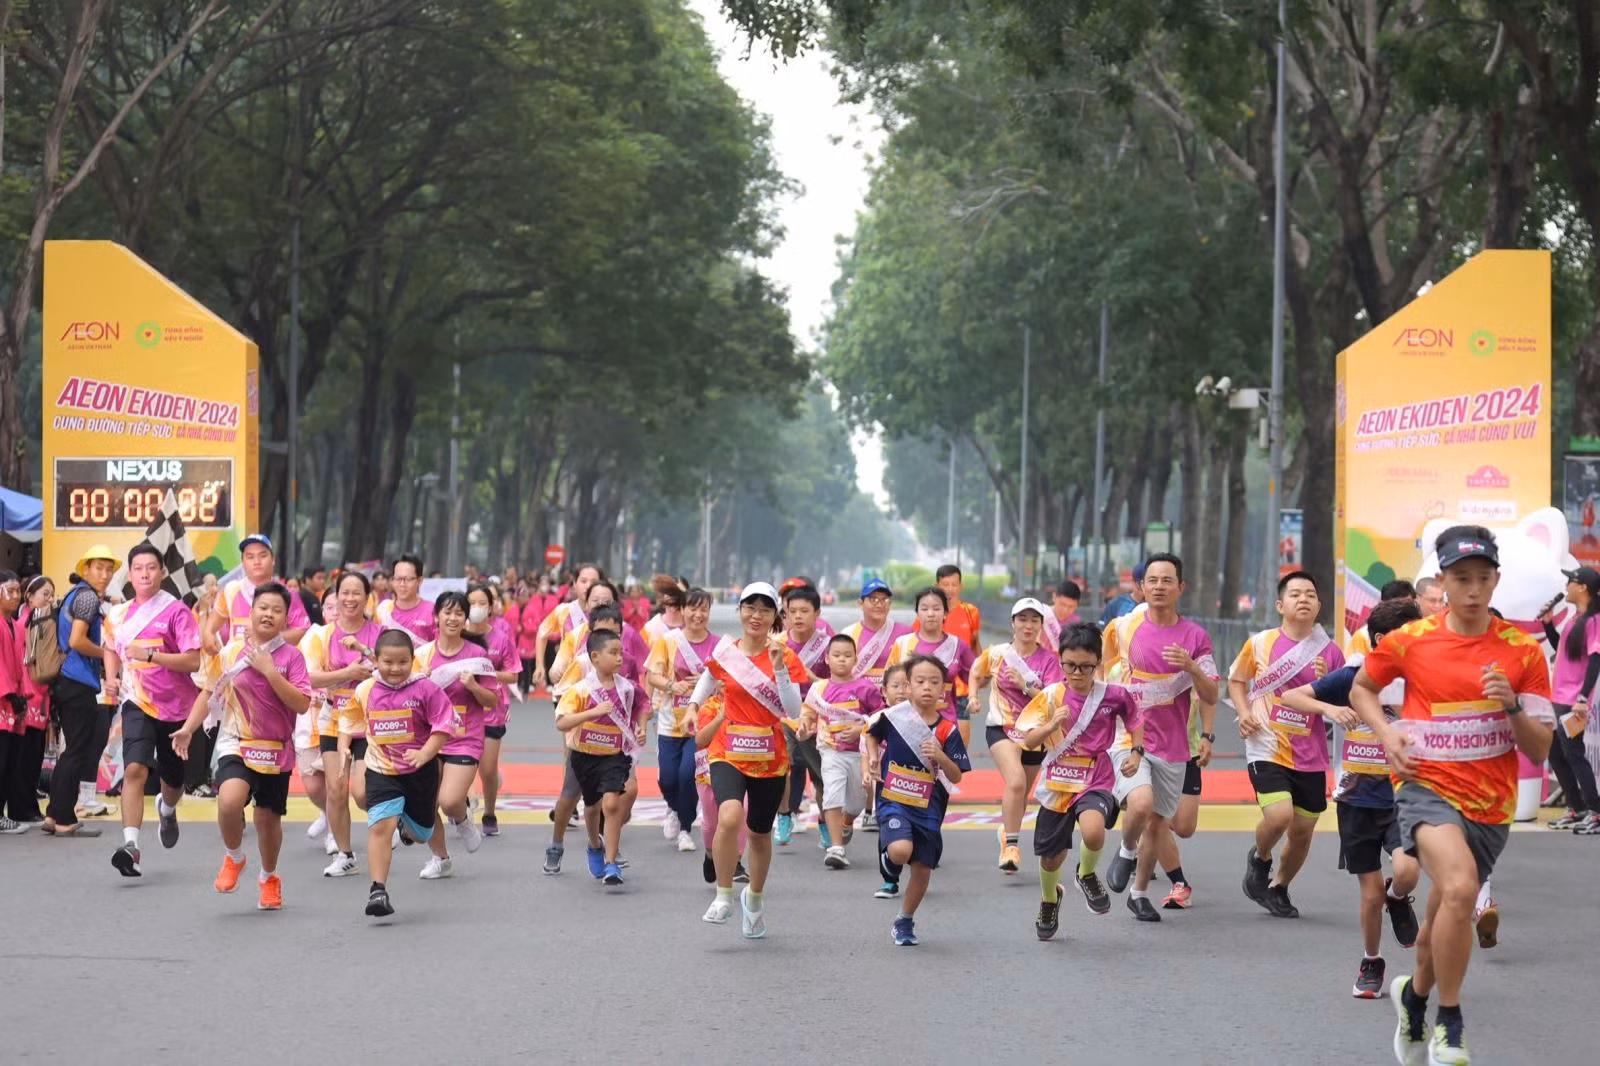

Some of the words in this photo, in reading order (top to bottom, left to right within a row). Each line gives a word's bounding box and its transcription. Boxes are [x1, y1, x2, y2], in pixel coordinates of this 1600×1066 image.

[57, 378, 127, 412] AEON
[127, 390, 197, 421] EKIDEN
[199, 401, 238, 427] 2024
[1356, 409, 1397, 434] AEON
[1398, 396, 1469, 431] EKIDEN
[1471, 384, 1540, 422] 2024
[53, 415, 86, 431] CUNG
[1513, 421, 1537, 439] VUI
[107, 461, 182, 481] NEXUS
[70, 489, 109, 522] 00
[1277, 659, 1296, 677] 2024
[373, 721, 408, 731] A0089-1
[585, 732, 617, 744] A0026-1
[732, 738, 769, 748] A0022-1
[1424, 733, 1450, 748] 2024
[1454, 731, 1496, 748] EKIDEN
[246, 750, 278, 760] A0098-1
[1050, 766, 1087, 779] A0063-1
[890, 777, 928, 793] A0065-1
